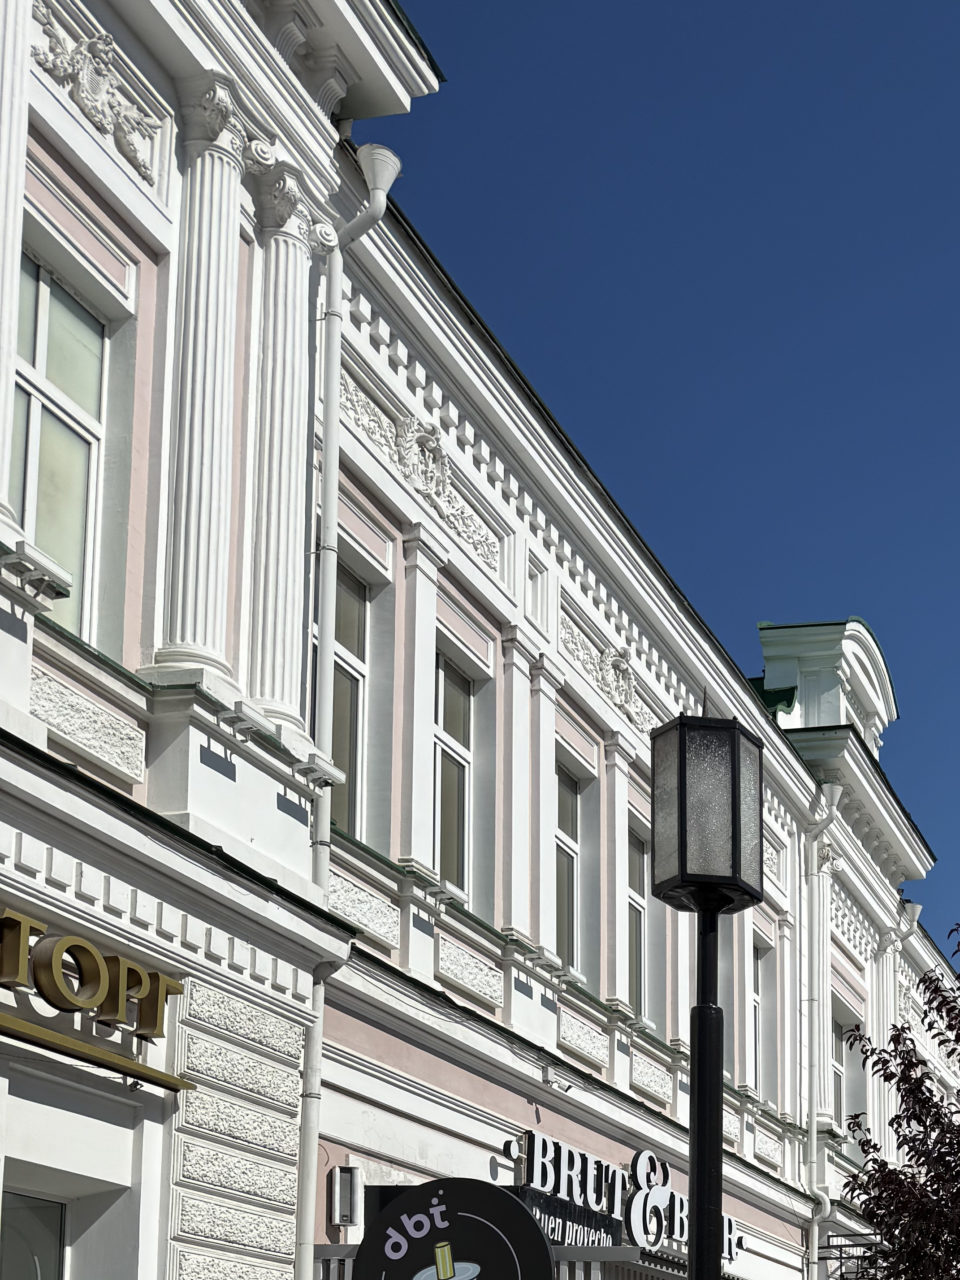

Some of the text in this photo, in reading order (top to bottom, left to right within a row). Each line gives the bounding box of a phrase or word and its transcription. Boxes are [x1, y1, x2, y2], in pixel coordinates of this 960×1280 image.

[384, 1204, 450, 1260] dbt
[530, 1130, 739, 1262] BRUT & BR
